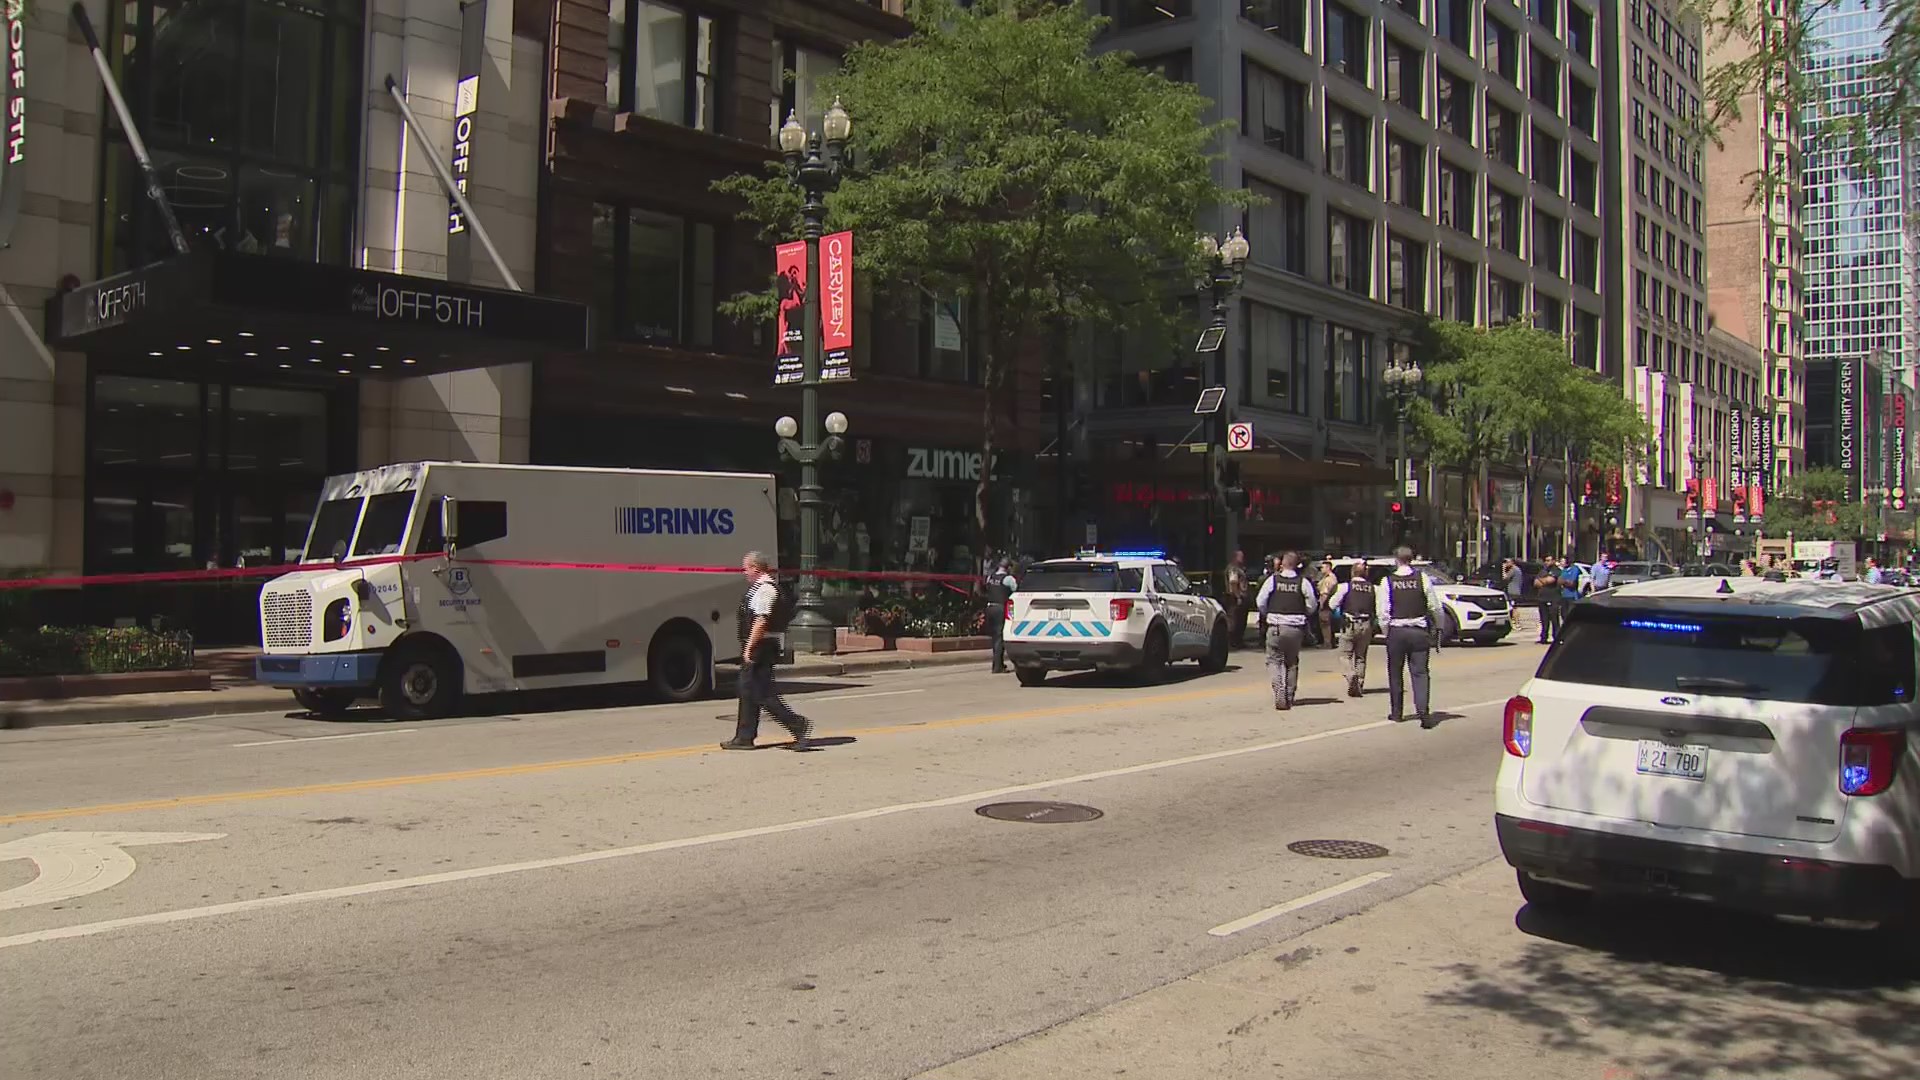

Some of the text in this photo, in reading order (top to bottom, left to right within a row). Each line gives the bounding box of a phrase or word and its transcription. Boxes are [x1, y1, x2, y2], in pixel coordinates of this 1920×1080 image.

[9, 19, 25, 165] OFF 5TH
[453, 116, 472, 173] OFF
[100, 288, 122, 320] OFF
[122, 281, 146, 313] 5TH
[828, 239, 846, 338] CARMEN
[381, 288, 432, 319] OFF
[435, 294, 483, 327] 5TH
[1841, 361, 1851, 394] SEVEN
[1841, 397, 1851, 432] THIRTY
[1841, 433, 1851, 469] BLOCK
[1751, 470, 1761, 488] rac
[637, 507, 735, 535] BRINKS
[456, 571, 464, 580] B
[1276, 582, 1299, 593] POLICE
[1351, 583, 1373, 593] POLICE
[1392, 580, 1418, 590] POLICE
[1651, 750, 1699, 772] 24 780
